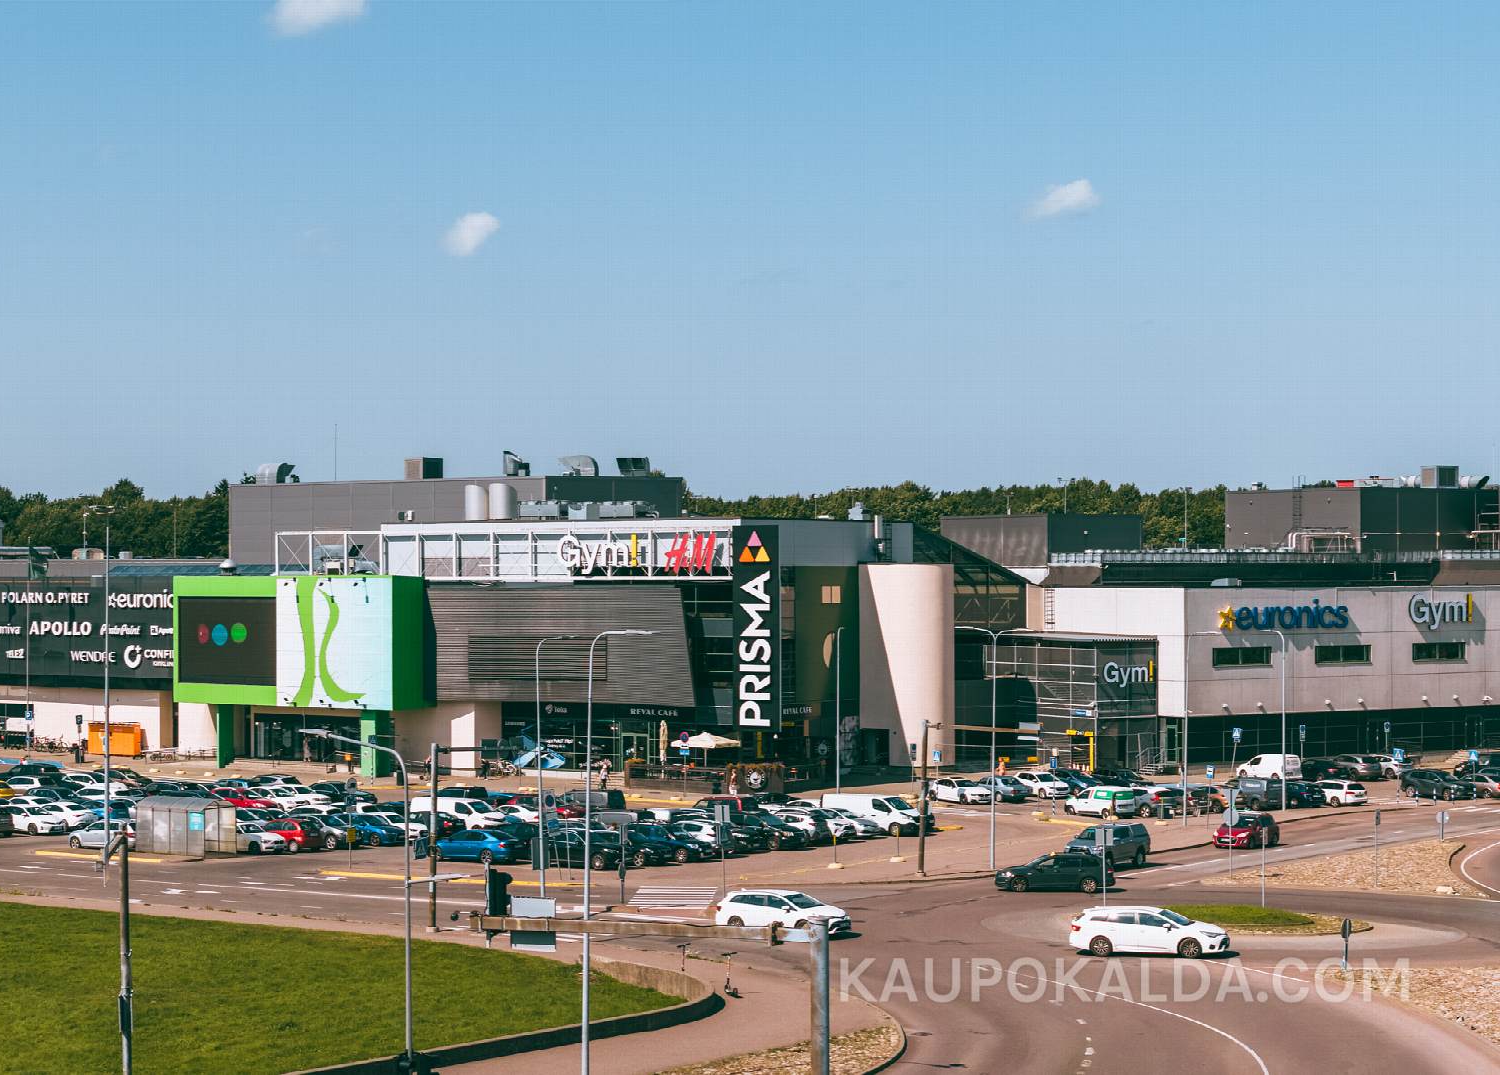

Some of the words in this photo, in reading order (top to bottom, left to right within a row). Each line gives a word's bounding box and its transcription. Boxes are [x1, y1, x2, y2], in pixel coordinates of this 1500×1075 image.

[557, 533, 637, 574] Gym!
[664, 531, 717, 575] H&M
[58, 592, 89, 603] PYRET
[117, 589, 174, 608] euronic
[1235, 598, 1349, 630] euronics
[1409, 593, 1473, 630] Gym!
[29, 621, 92, 635] APOLLO
[738, 571, 771, 728] PRISMA
[1103, 660, 1154, 687] Gym!
